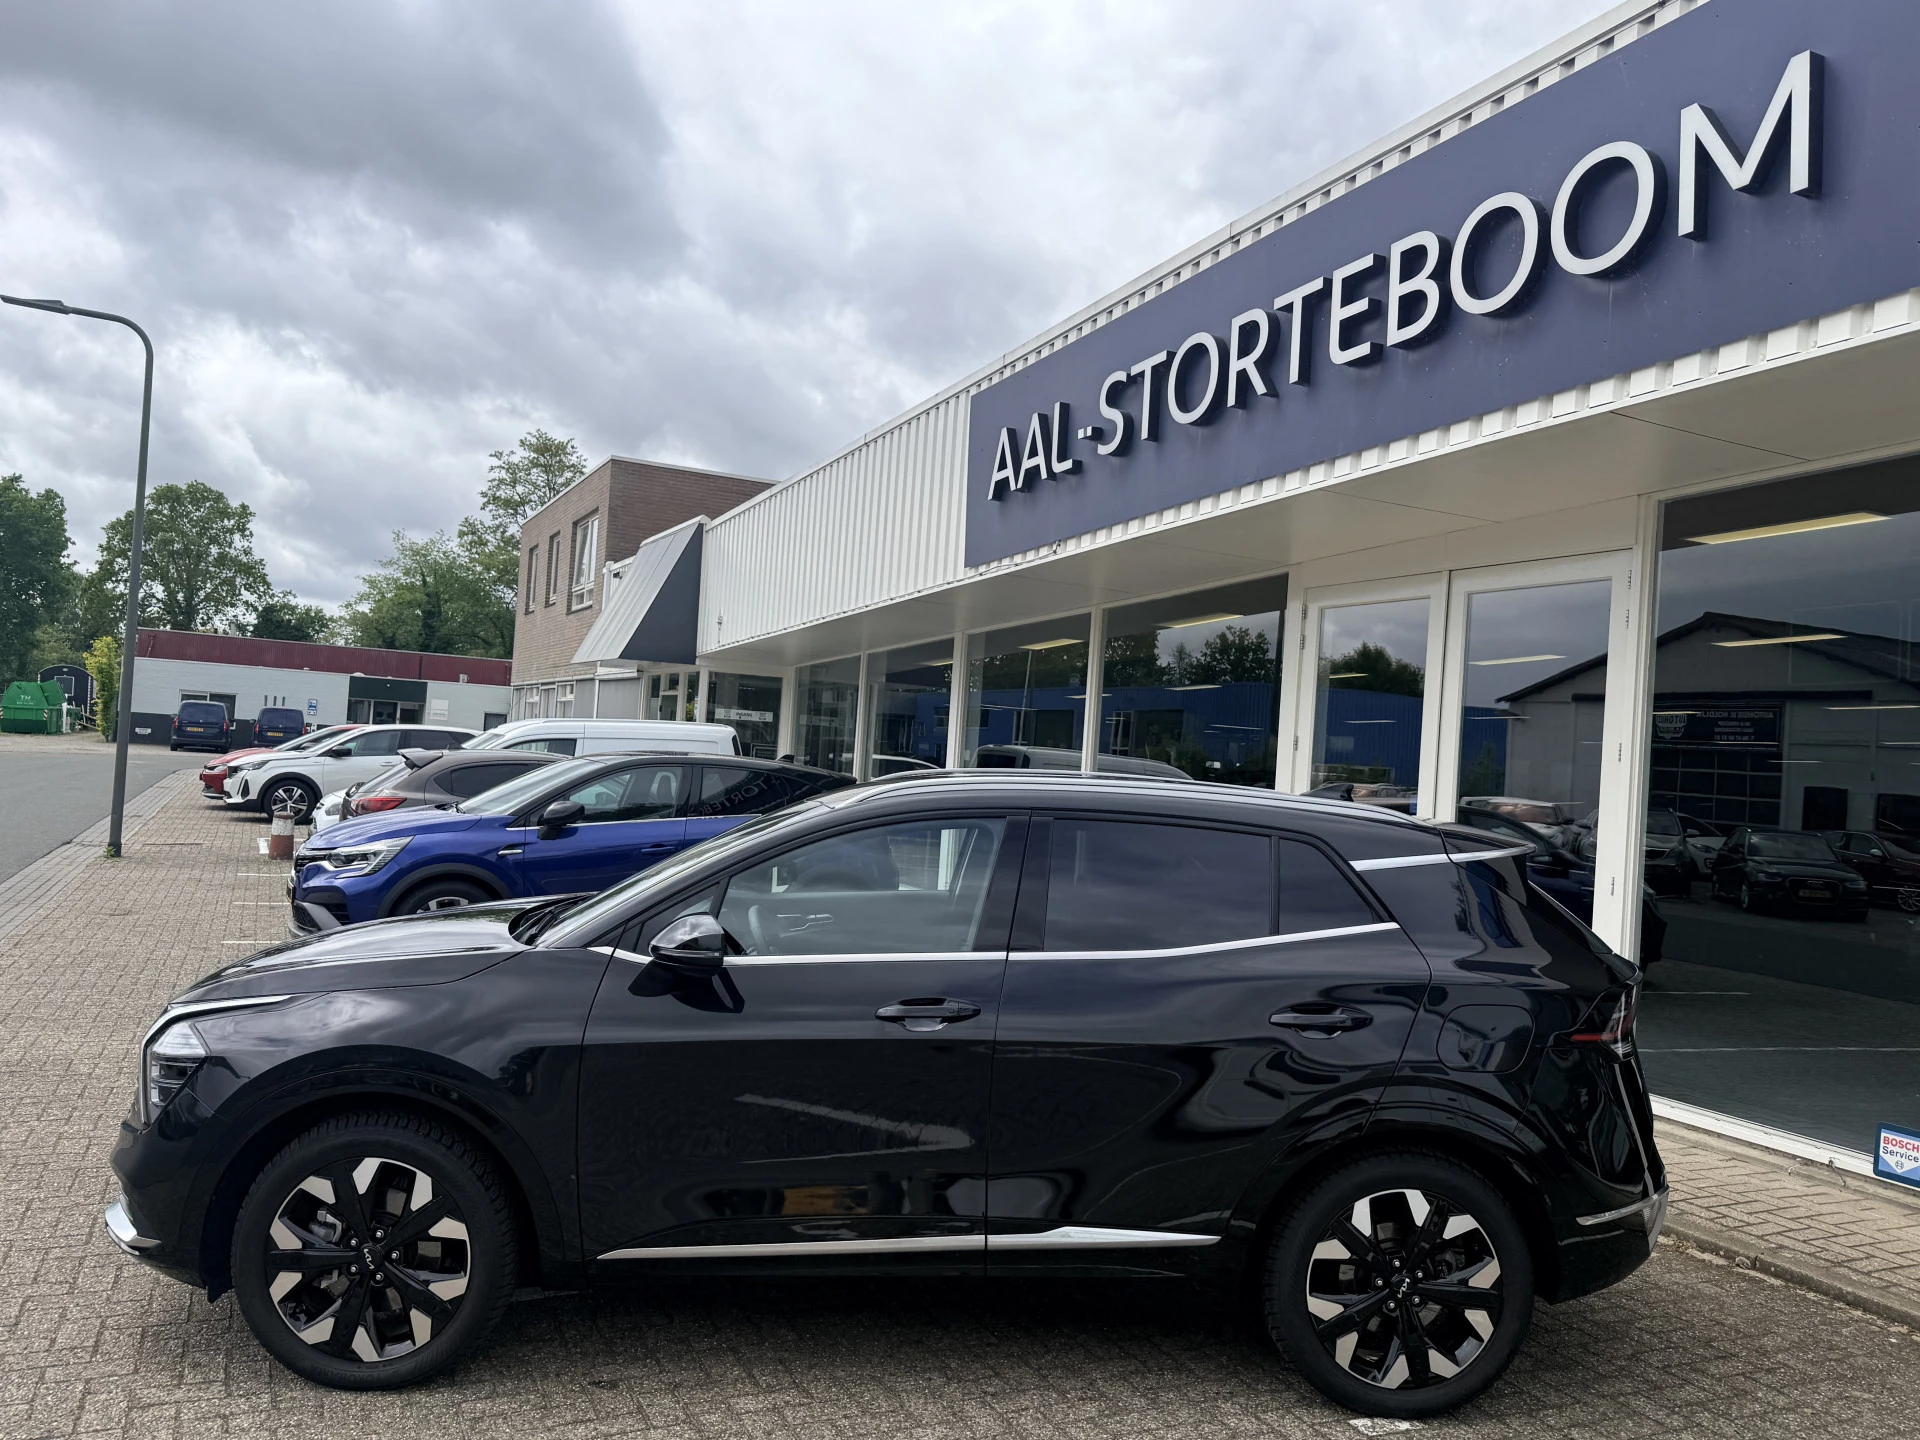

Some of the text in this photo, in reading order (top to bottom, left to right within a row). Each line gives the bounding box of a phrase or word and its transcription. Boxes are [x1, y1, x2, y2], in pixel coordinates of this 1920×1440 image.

[988, 50, 1822, 501] AAL-STORTEBOOM
[1883, 1136, 1920, 1153] BOSCH
[1882, 1146, 1919, 1163] Service
